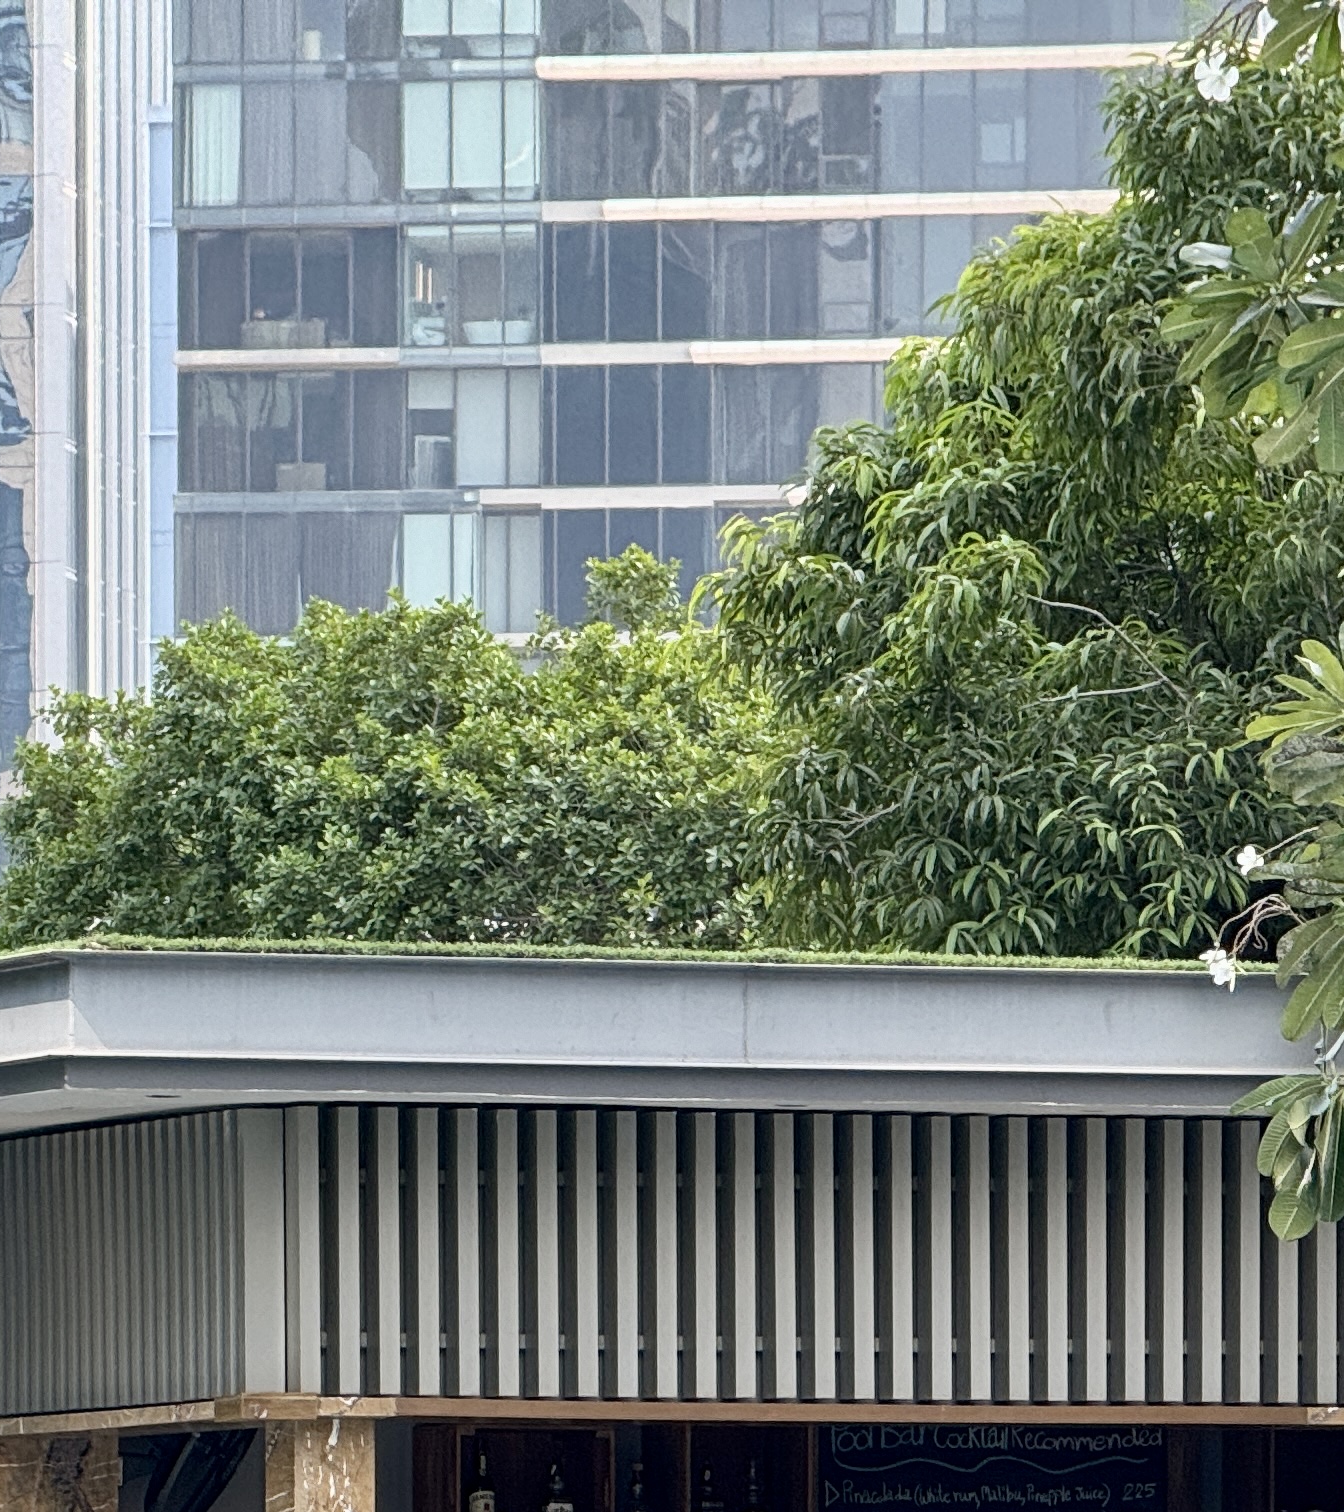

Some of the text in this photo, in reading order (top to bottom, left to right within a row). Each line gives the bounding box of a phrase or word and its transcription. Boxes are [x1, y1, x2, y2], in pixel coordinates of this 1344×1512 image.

[830, 1425, 873, 1451] Pool
[880, 1426, 925, 1449] Bar
[1122, 1482, 1156, 1501] 225
